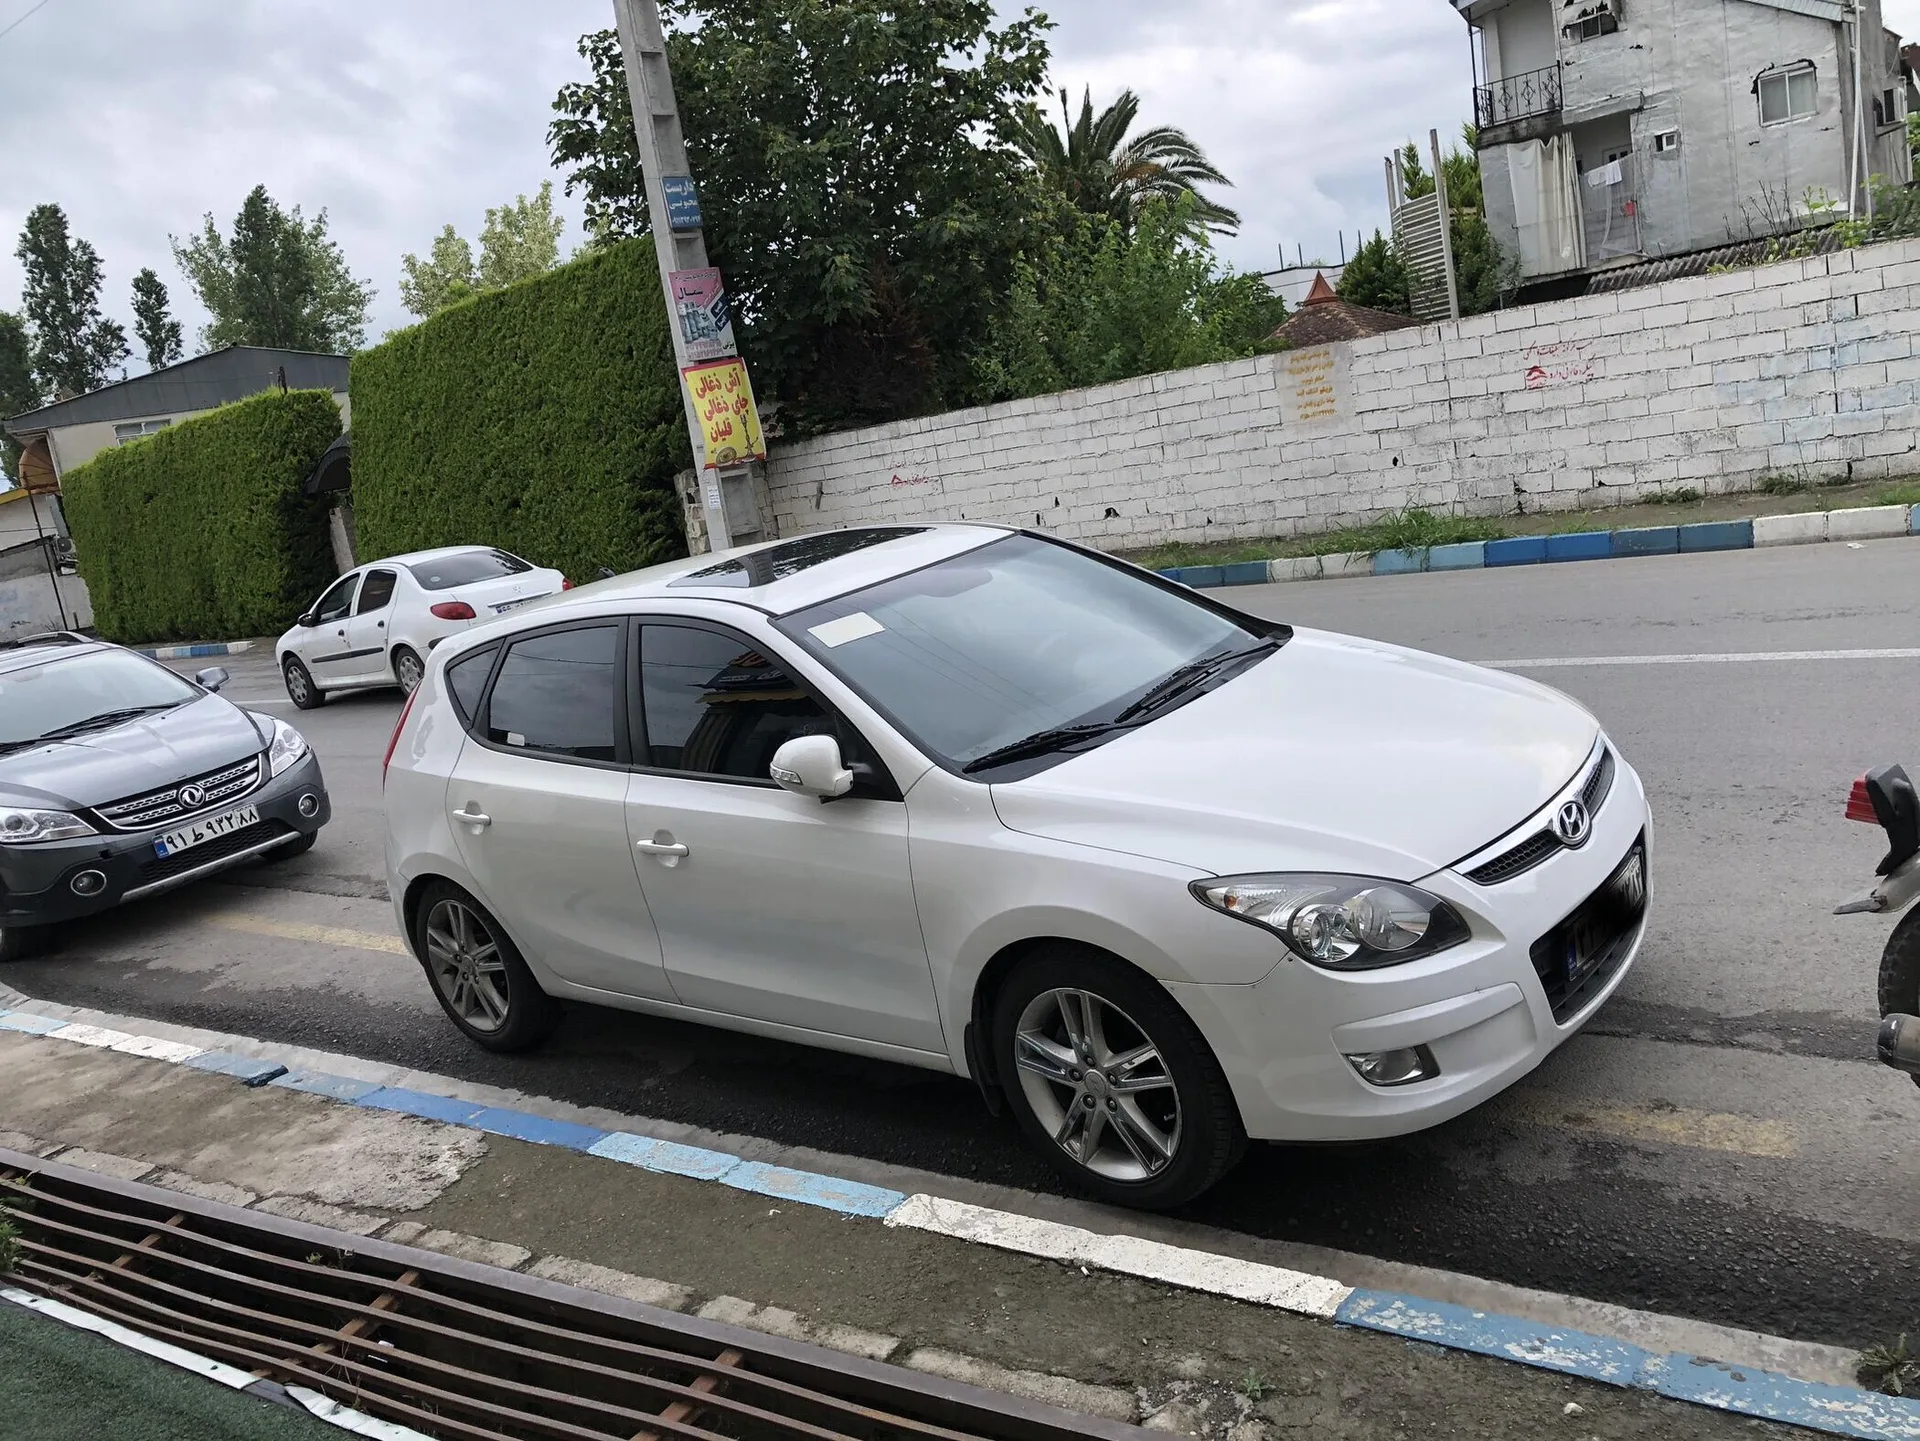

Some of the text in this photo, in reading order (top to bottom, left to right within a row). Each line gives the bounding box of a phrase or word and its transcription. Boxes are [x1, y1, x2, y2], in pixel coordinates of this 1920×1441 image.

[696, 373, 722, 399] ذغالی
[704, 395, 729, 421] ذغالی
[710, 417, 733, 442] قلیان
